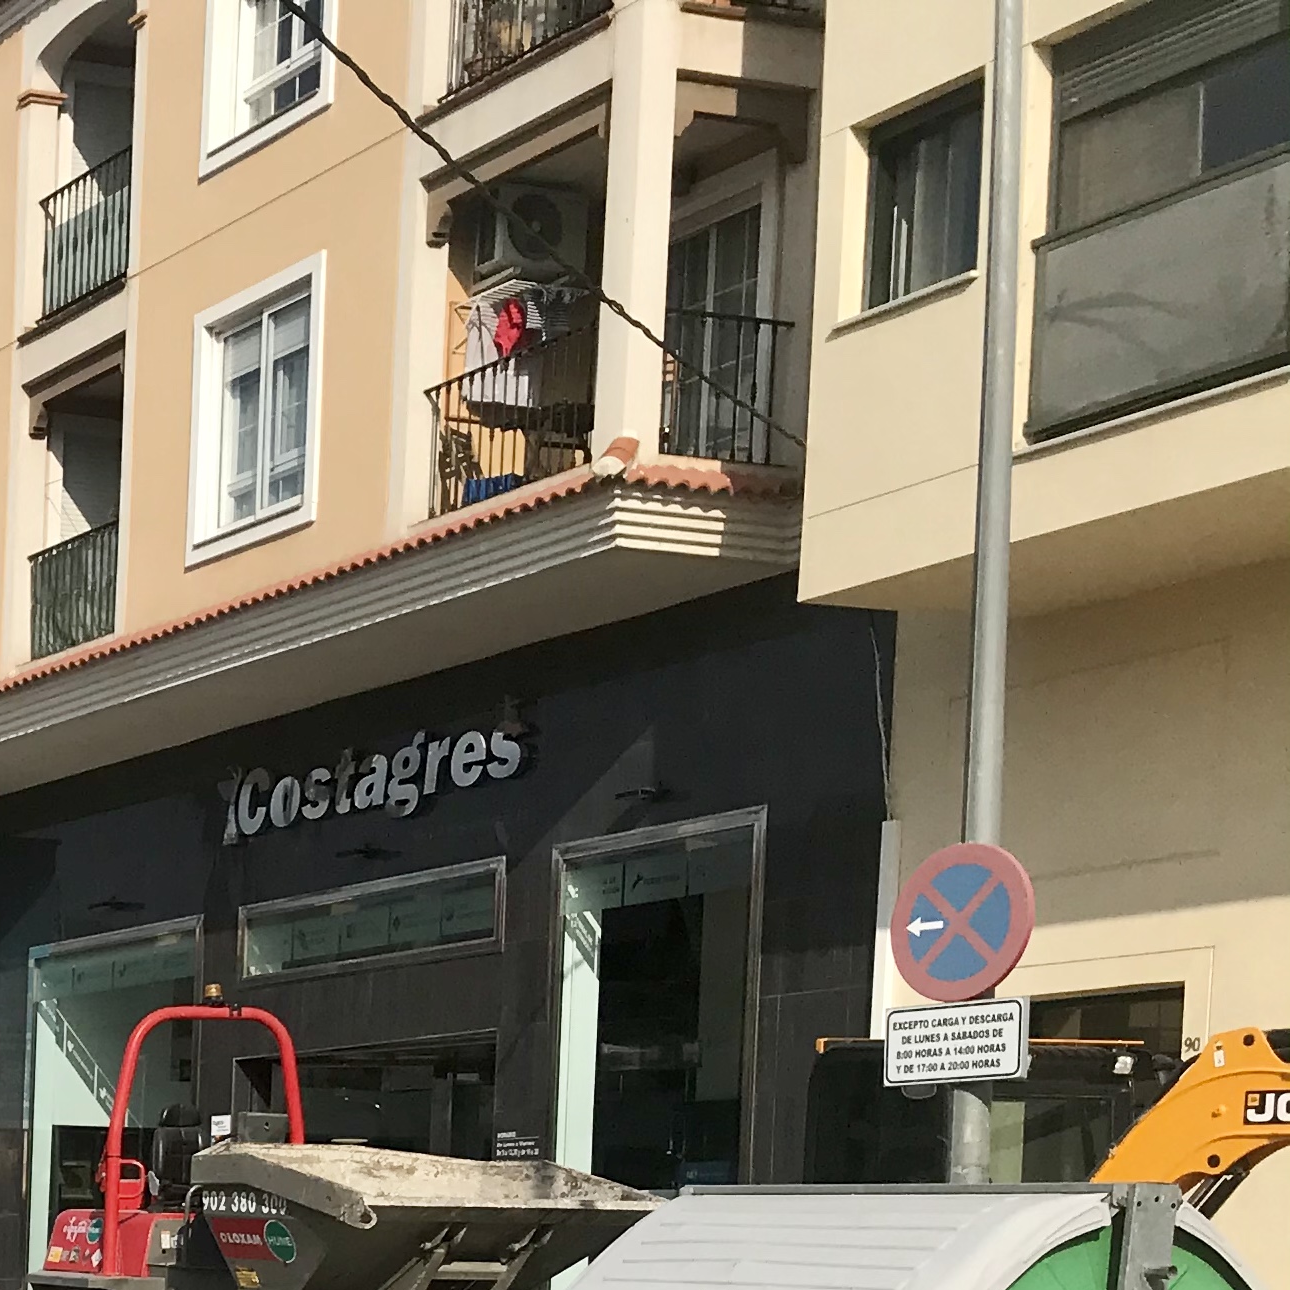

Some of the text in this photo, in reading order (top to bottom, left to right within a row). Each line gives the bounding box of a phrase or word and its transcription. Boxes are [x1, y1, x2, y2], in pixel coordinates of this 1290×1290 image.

[892, 1012, 1015, 1031] EXCEPTO CARGA Y DESCARGA
[901, 1027, 1004, 1045] DE LUNES A SABADOS DE
[1184, 1036, 1201, 1053] 90
[915, 1047, 943, 1058] HORAS
[945, 1046, 952, 1056] A
[954, 1045, 975, 1055] 14:00
[977, 1043, 1007, 1053] HORAS
[896, 1065, 902, 1074] Y
[904, 1064, 914, 1074] DE
[940, 1061, 946, 1071] A
[947, 1059, 970, 1071] 20:00
[971, 1058, 1001, 1069] HORAS
[202, 1190, 288, 1215] 902 380 300
